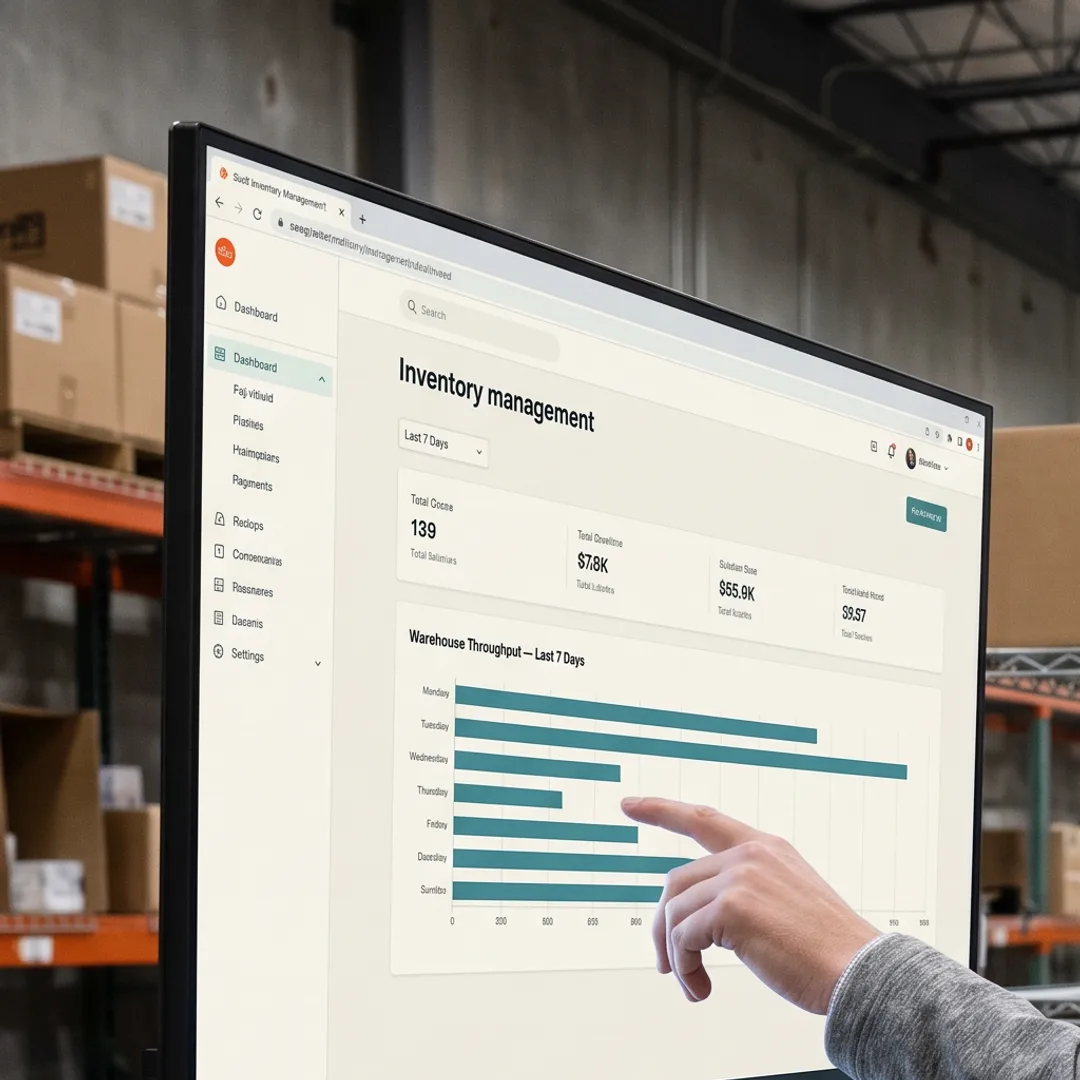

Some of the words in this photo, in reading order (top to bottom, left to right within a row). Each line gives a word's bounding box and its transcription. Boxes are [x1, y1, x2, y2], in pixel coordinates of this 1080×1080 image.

[234, 302, 278, 322] Dashboard
[421, 305, 447, 321] Search
[234, 353, 277, 373] Dashboard
[399, 357, 483, 408] Inventory
[488, 388, 595, 432] management
[405, 429, 422, 443] Last
[423, 434, 429, 444] 7
[430, 435, 449, 450] Days
[411, 493, 429, 507] Total
[411, 518, 436, 540] 139
[231, 647, 264, 664] Settings
[409, 629, 466, 650] Warehouse
[467, 638, 522, 659] Throughput
[535, 648, 554, 663] Last
[556, 651, 562, 663] 7
[564, 651, 585, 668] Days
[450, 917, 455, 926] 0
